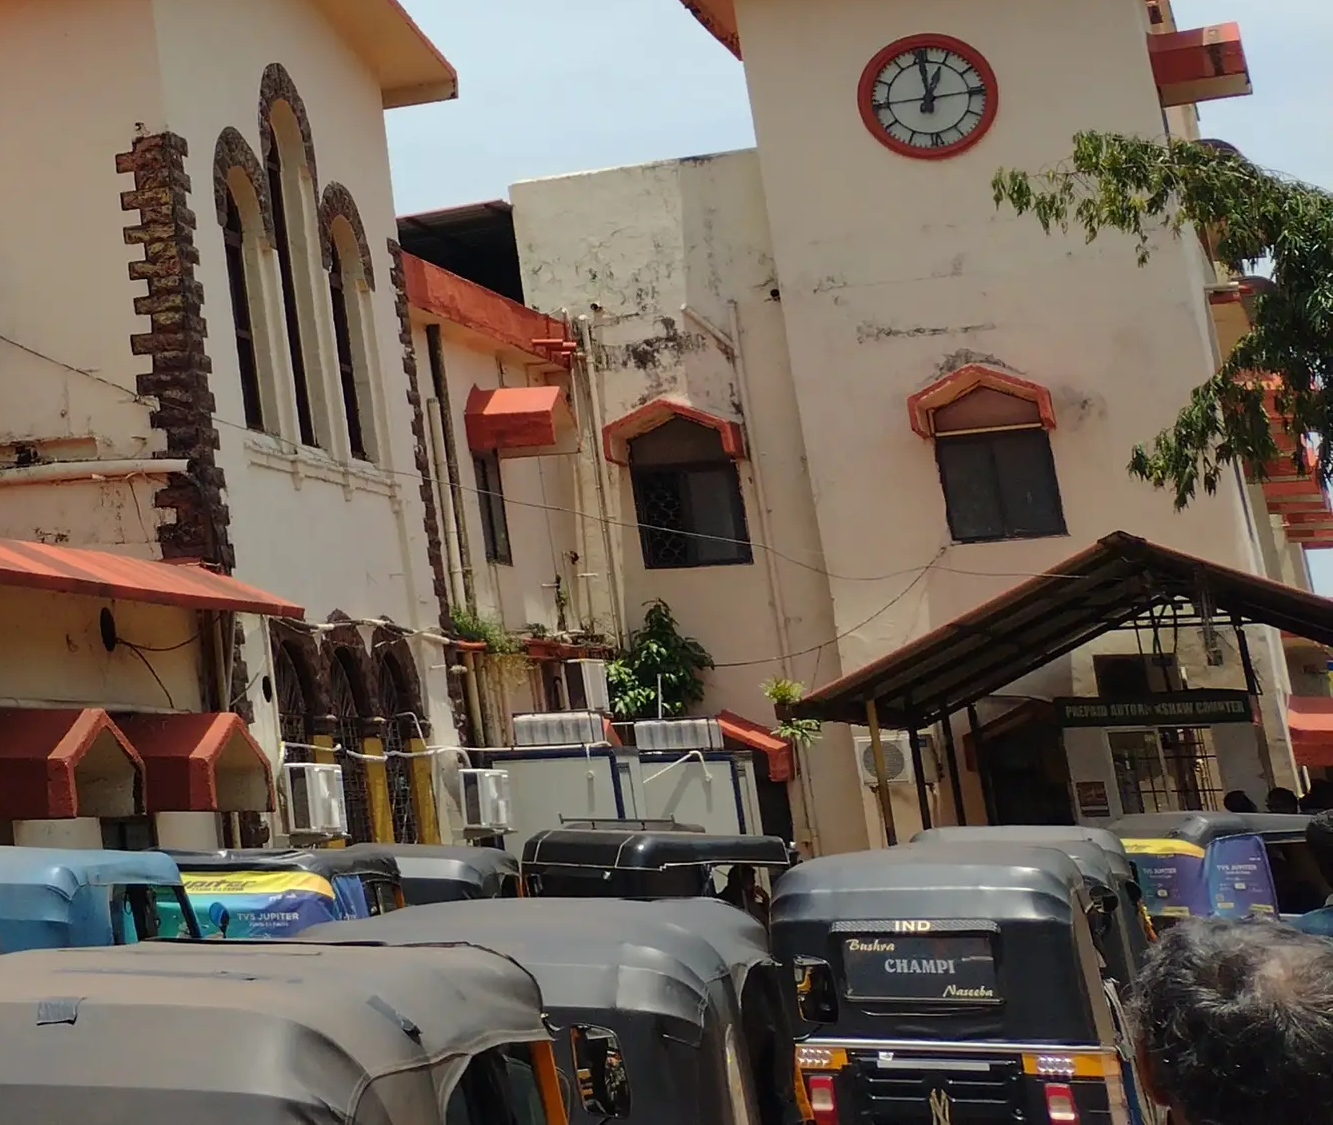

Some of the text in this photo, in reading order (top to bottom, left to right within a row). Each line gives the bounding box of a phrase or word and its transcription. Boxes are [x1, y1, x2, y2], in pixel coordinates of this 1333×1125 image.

[237, 912, 299, 921] TVS JUPITER
[895, 920, 931, 931] IND
[846, 939, 895, 951] Bushra
[884, 959, 956, 974] CHAMPI
[943, 985, 993, 997] Naseeba
